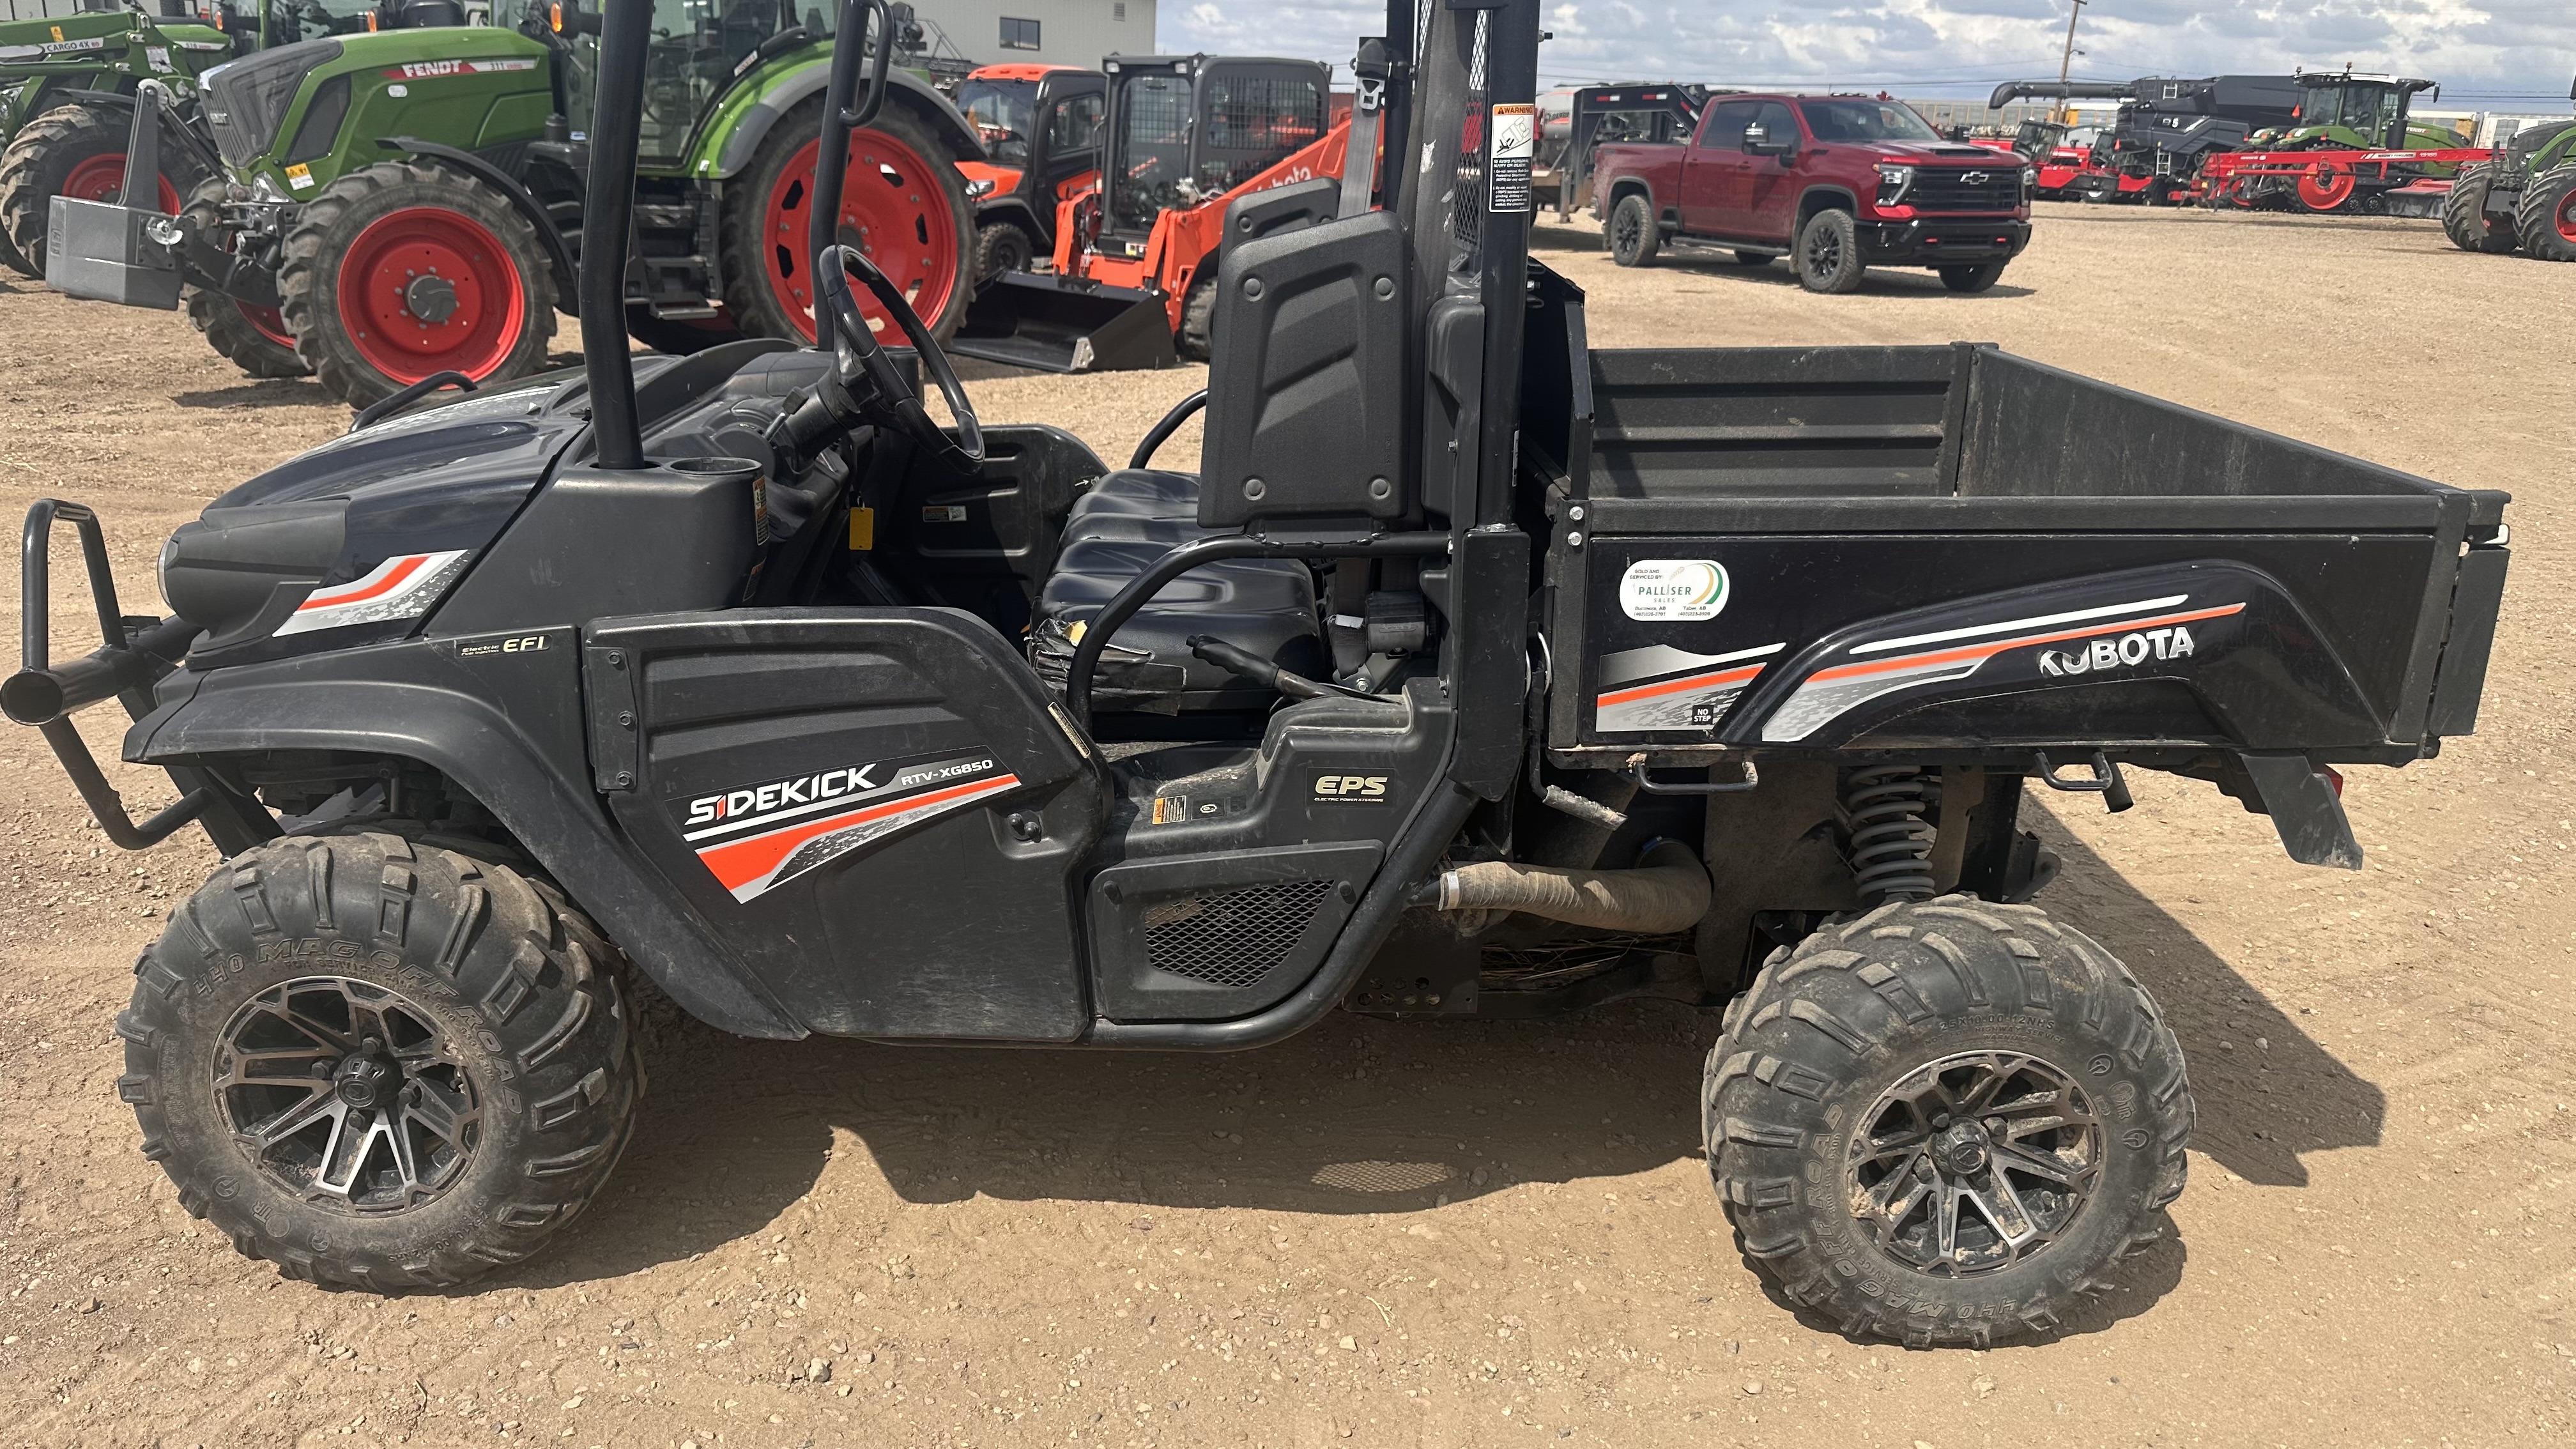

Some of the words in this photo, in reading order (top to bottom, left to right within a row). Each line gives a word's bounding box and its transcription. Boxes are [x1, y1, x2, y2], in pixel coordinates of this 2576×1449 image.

[47, 42, 77, 52] CARGO
[79, 40, 89, 49] 4X
[402, 59, 462, 78] FENDT
[490, 61, 504, 71] 311
[1638, 584, 1692, 595] PALLISER
[503, 636, 544, 652] EFI
[2038, 626, 2195, 677] KUBOTA
[901, 759, 993, 786] RTV-XG850
[684, 763, 877, 825] SIDEKICK
[1315, 776, 1388, 795] EPS
[316, 958, 376, 975] SERVICE
[193, 953, 245, 995] 440
[257, 937, 362, 963] MAG
[370, 949, 459, 997] OFF
[453, 1006, 523, 1114] ROAD
[1924, 1034, 1943, 1045] NOT
[1950, 1028, 1968, 1037] FOR
[2026, 1027, 2066, 1045] SERVICE
[1805, 1102, 1843, 1209] ROAD
[1826, 1195, 1836, 1214] 800
[1811, 1217, 1858, 1276] OFF
[1837, 1232, 1856, 1255] CALL
[1858, 1257, 1899, 1288] SERVICE
[1855, 1279, 1947, 1317] MAG
[1956, 1298, 2018, 1319] 440
